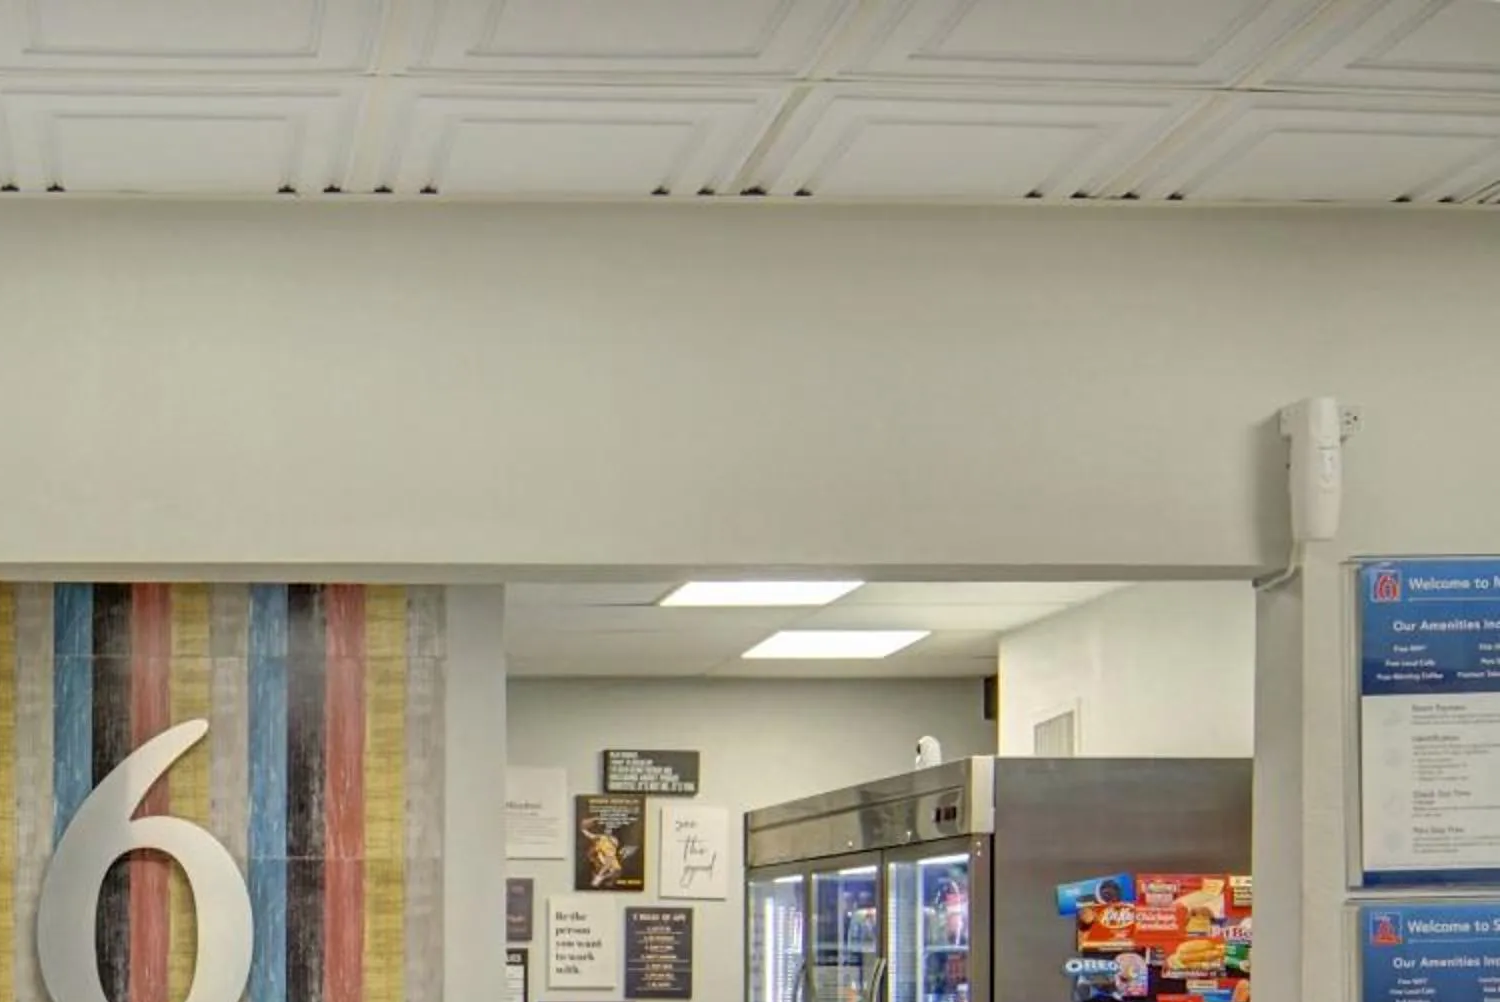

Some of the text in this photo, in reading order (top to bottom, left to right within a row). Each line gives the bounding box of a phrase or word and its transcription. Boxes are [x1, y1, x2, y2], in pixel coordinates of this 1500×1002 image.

[1409, 578, 1470, 591] Welcome
[1475, 579, 1489, 590] to
[1393, 620, 1416, 632] Our
[1420, 620, 1480, 631] Amenities
[1408, 920, 1470, 933] Welcome
[1474, 920, 1489, 932] to
[1065, 959, 1120, 974] OREO
[1393, 957, 1416, 968] Our
[1420, 956, 1480, 967] Amenities
